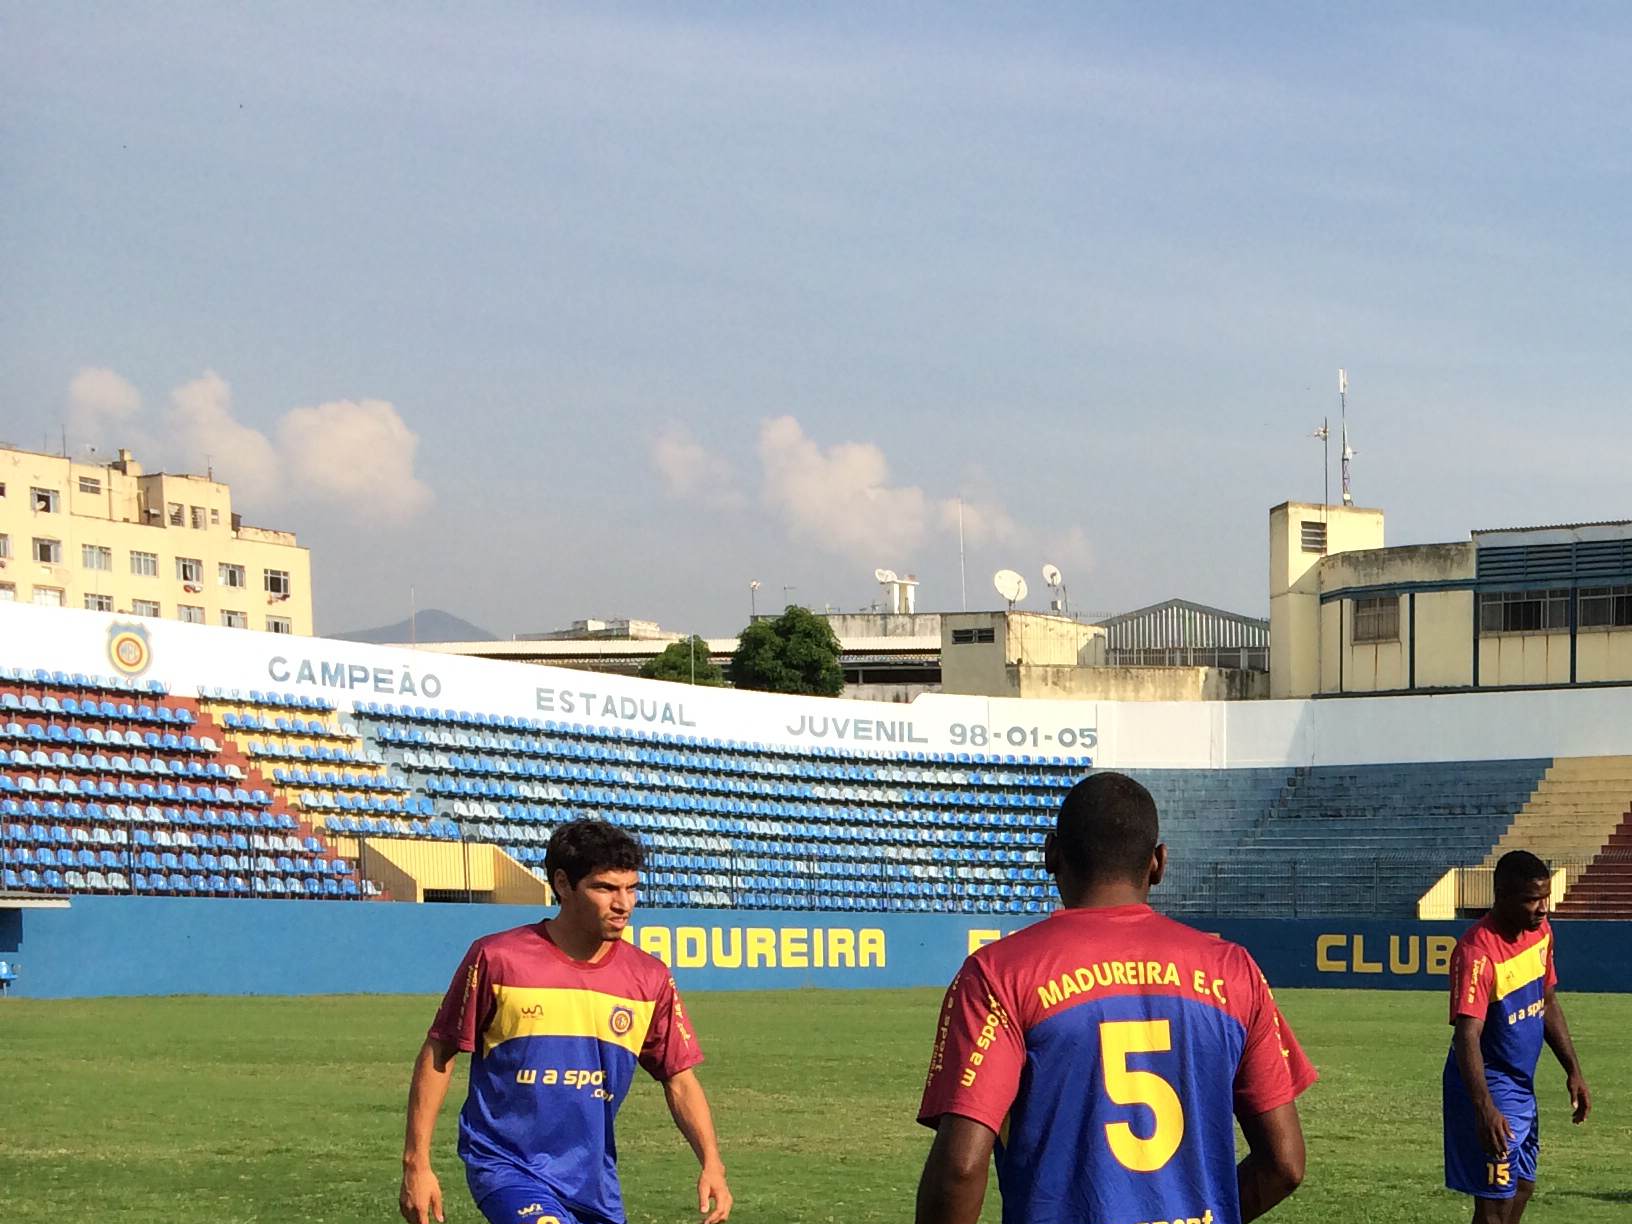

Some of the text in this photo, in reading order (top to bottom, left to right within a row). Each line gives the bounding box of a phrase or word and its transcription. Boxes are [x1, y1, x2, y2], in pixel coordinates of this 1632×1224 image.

[267, 655, 1098, 750] CAMPEÃO ESTADUAL JUVENIL 98-01-05
[1036, 960, 1181, 1009] MADUREIRA
[542, 1069, 558, 1085] a
[563, 1070, 606, 1090] spo
[1099, 1018, 1185, 1173] 5
[1486, 1162, 1510, 1186] 15
